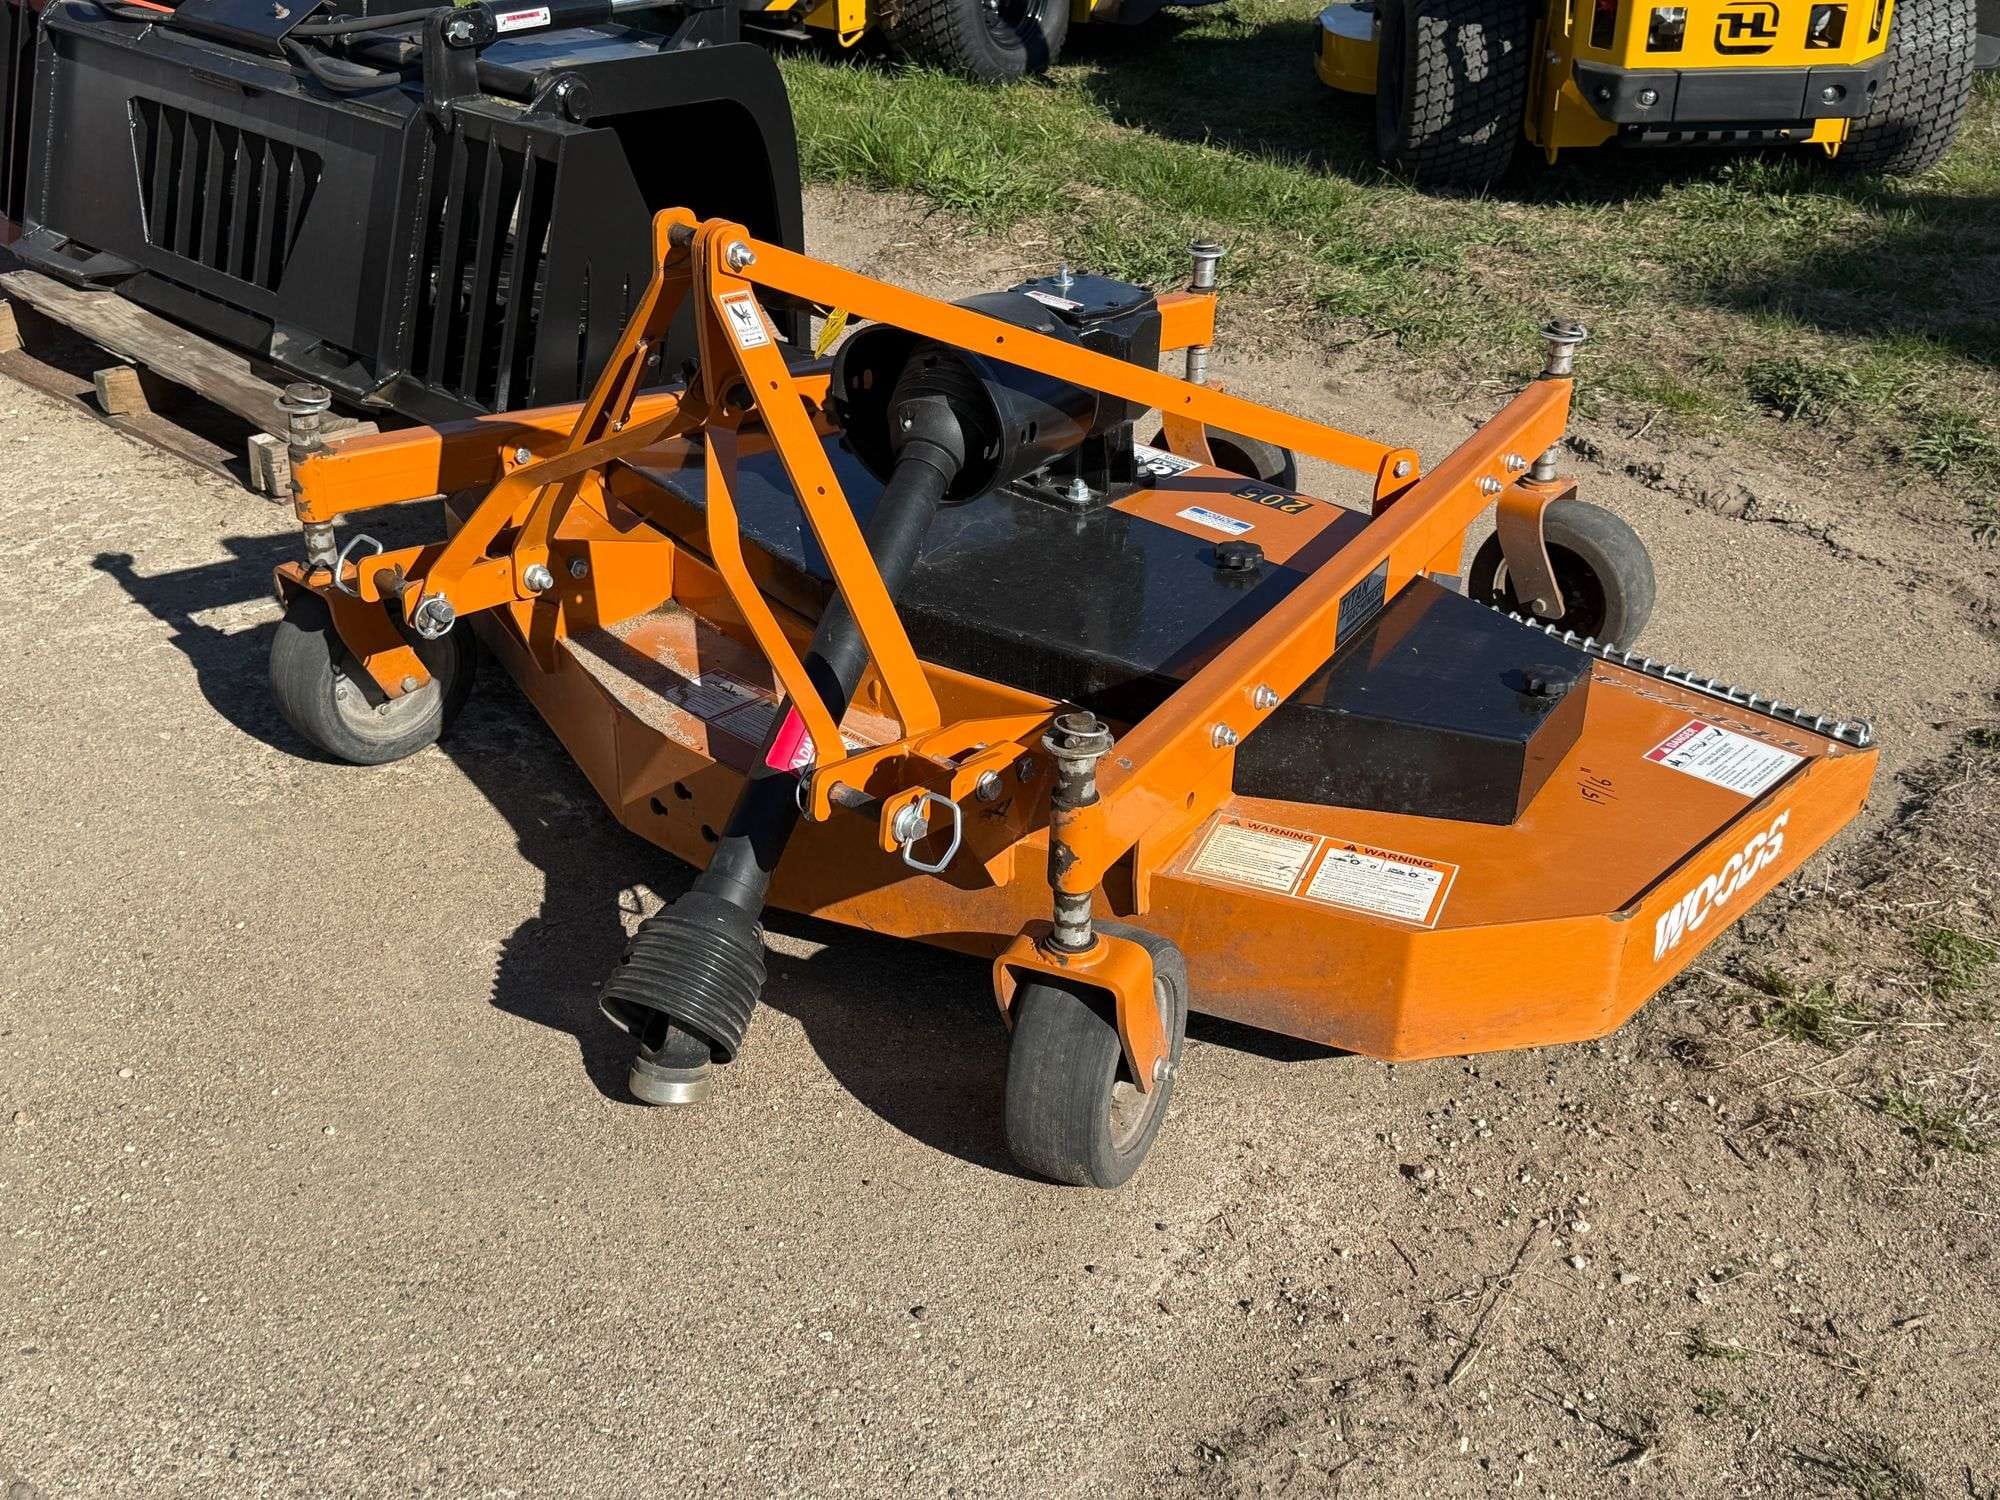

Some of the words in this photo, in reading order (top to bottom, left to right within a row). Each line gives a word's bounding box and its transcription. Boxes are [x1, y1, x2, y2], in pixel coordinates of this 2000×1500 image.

[1237, 488, 1308, 513] 205
[1669, 727, 1697, 751] DANGER
[1248, 822, 1313, 842] WARNING
[1365, 848, 1435, 868] WARNING
[1654, 808, 1791, 962] WOODS
